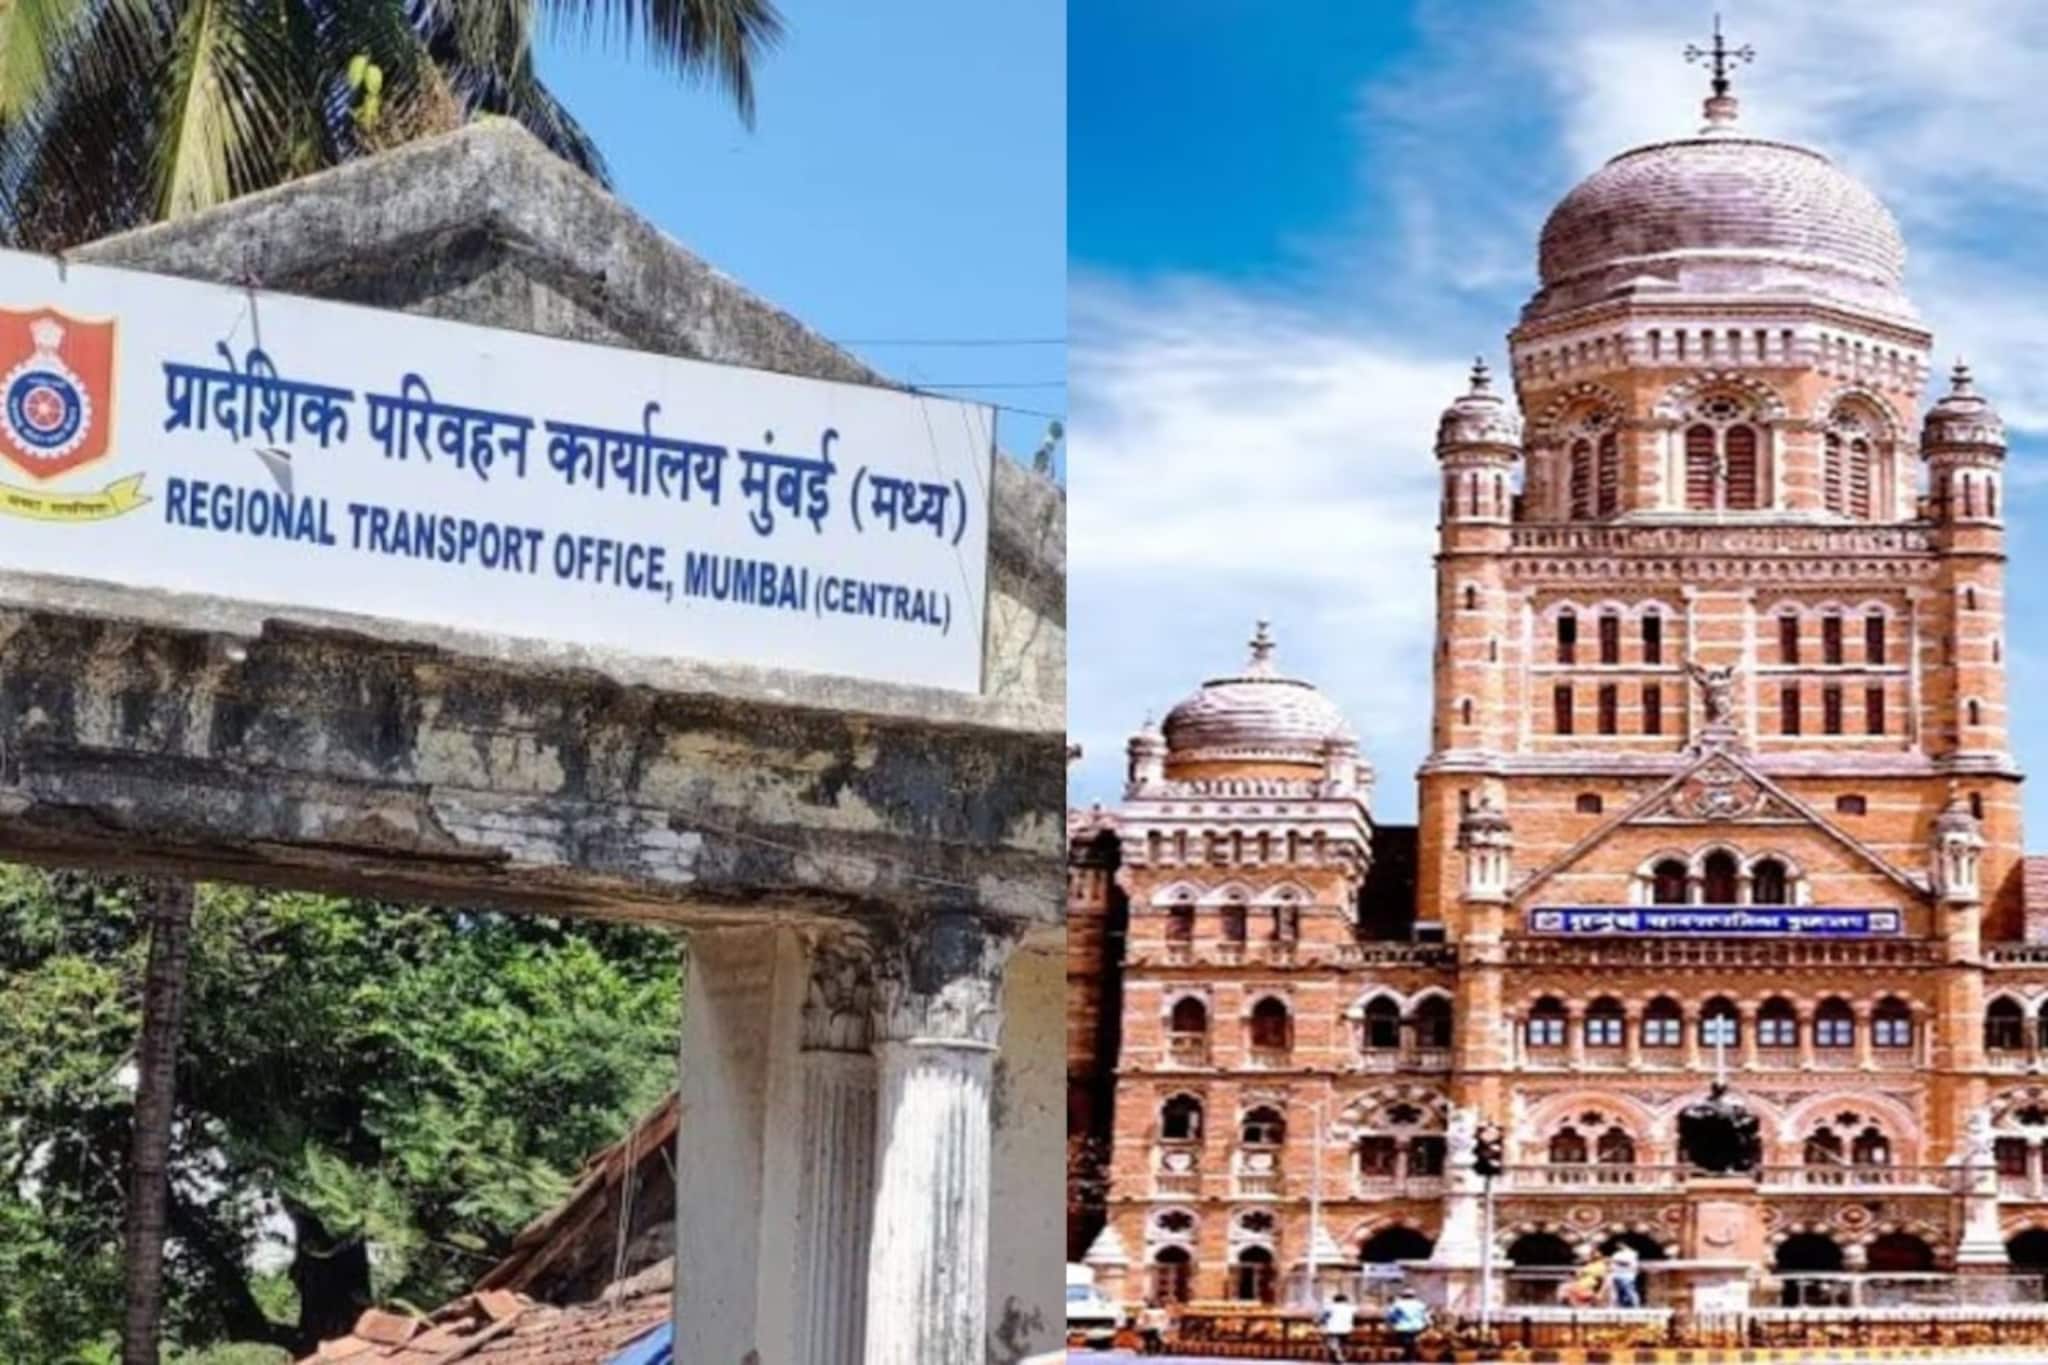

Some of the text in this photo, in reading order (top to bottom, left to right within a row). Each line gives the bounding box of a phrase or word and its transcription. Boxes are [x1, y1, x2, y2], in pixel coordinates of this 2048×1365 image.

[162, 341, 354, 449] प्रादेशिक
[365, 373, 535, 481] परिवहन
[544, 402, 728, 507] कार्यालय
[739, 430, 839, 537] मुंबई
[851, 466, 968, 546] (मध्य)
[165, 476, 951, 637] REGIONAL TRANSPORT OFFICE, MUMBAI (CENTRAL)
